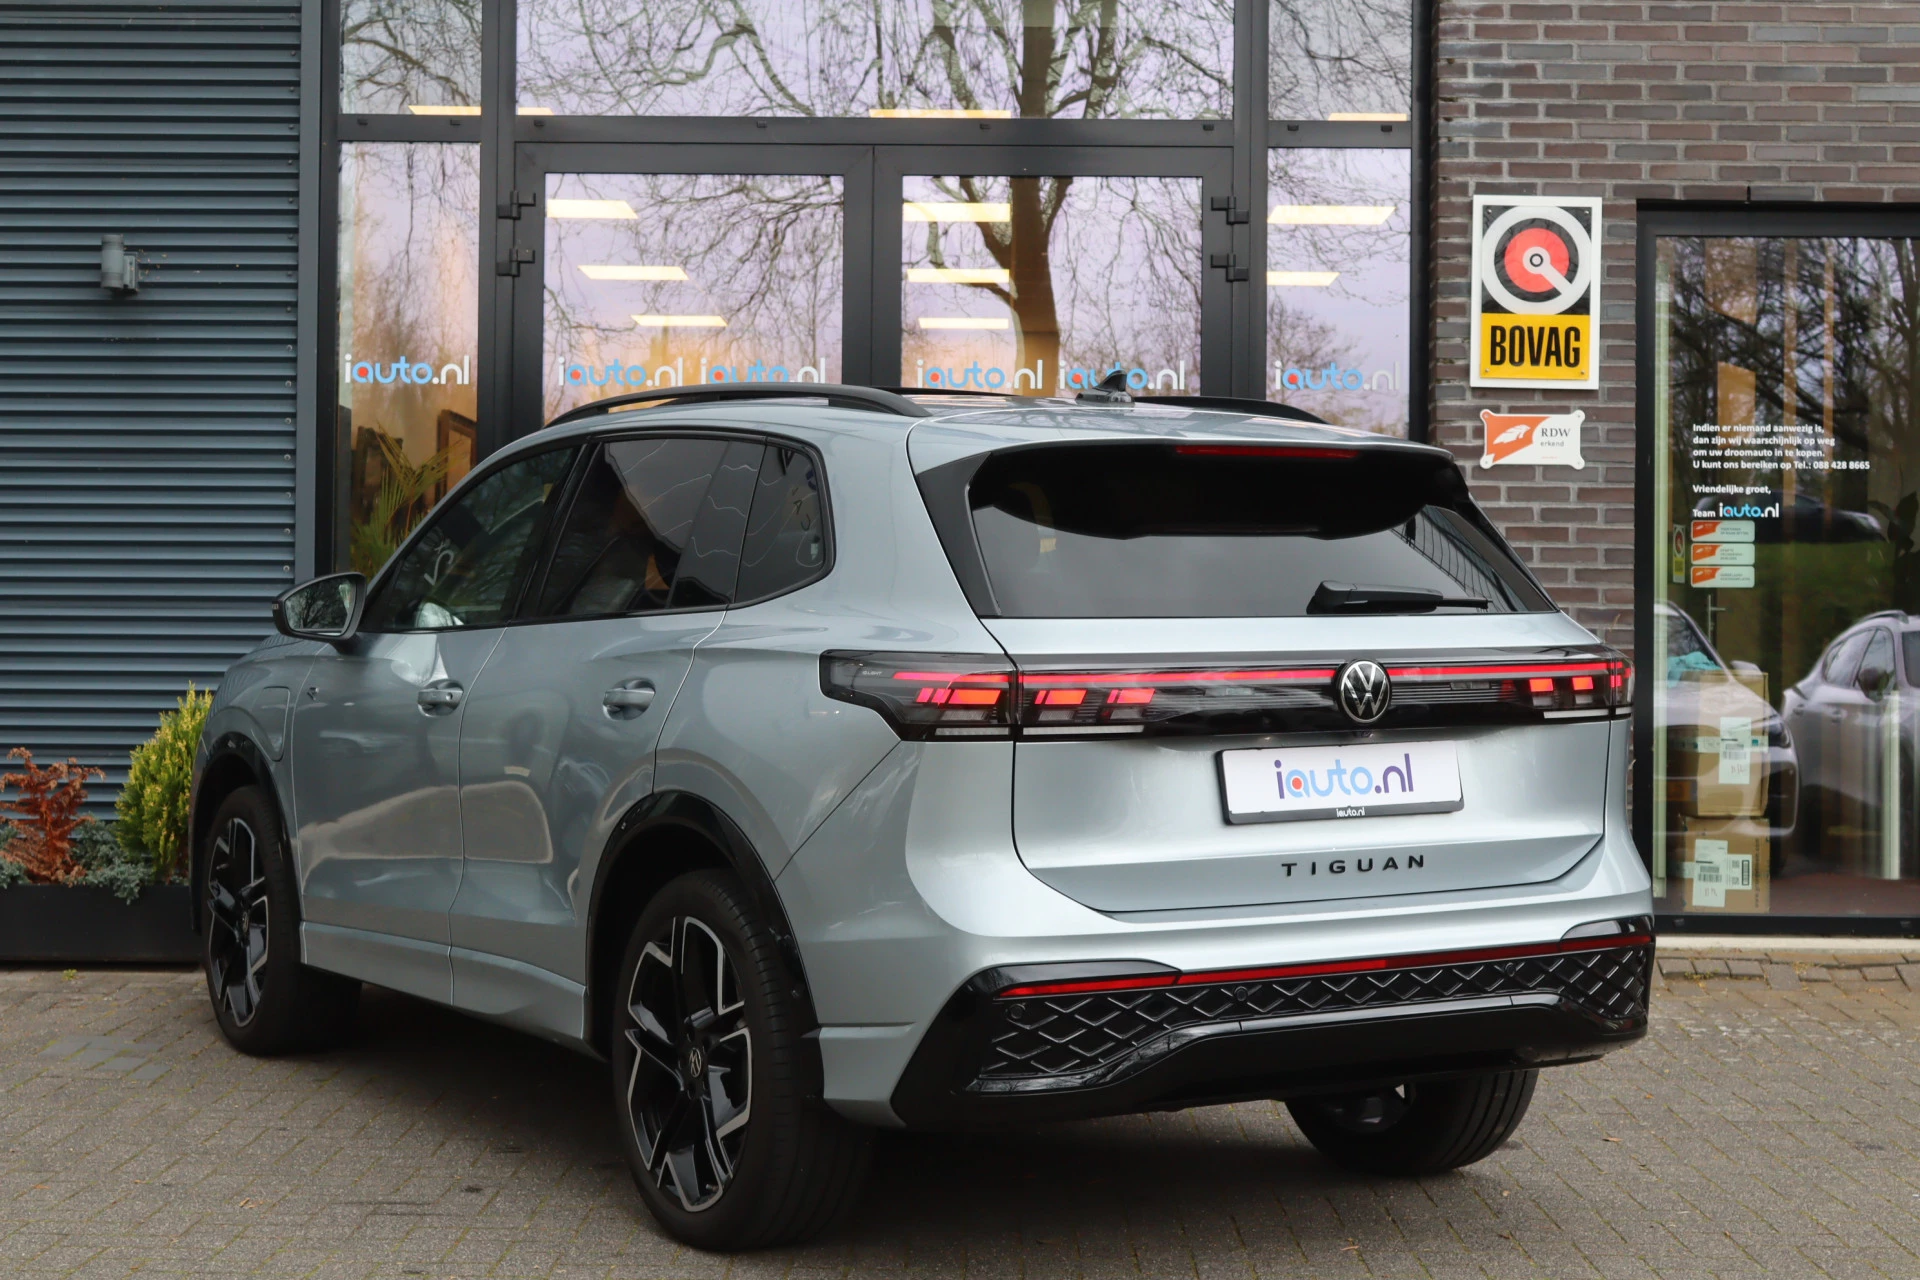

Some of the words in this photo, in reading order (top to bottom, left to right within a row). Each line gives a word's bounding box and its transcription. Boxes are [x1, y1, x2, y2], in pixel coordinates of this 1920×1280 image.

[1490, 325, 1581, 368] BOVAG
[344, 353, 470, 384] iauto.nl
[558, 356, 684, 387] iauto.nl
[917, 359, 1043, 389] iauto.nl
[1274, 360, 1401, 391] iauto.nl
[1541, 428, 1571, 437] RDW
[1693, 424, 1720, 432] Indien
[1733, 424, 1771, 432] niemand
[1773, 424, 1813, 434] aanwezig
[1815, 424, 1824, 434] is,
[1693, 436, 1709, 444] dan
[1711, 436, 1726, 446] zijn
[1728, 436, 1741, 446] wij
[1743, 436, 1802, 446] waarschijnlijk
[1804, 437, 1815, 446] op
[1817, 437, 1835, 446] weg
[1693, 449, 1707, 457] om
[1709, 449, 1722, 457] uw
[1724, 448, 1773, 457] droomauto
[1774, 448, 1783, 457] in
[1785, 449, 1794, 457] te
[1796, 448, 1825, 459] kopen.
[1693, 460, 1700, 469] U
[1702, 460, 1722, 469] kunt
[1723, 461, 1739, 469] ons
[1741, 460, 1778, 469] bereiken
[1780, 462, 1792, 471] op
[1813, 461, 1829, 470] 088
[1831, 461, 1847, 470] 428
[1849, 461, 1870, 470] 8665
[1692, 485, 1744, 495] Vriendelijke
[1745, 485, 1771, 495] groet,
[1692, 509, 1716, 517] Team
[1719, 502, 1779, 518] iauto.nl
[1274, 753, 1414, 799] iauto.nl
[1281, 854, 1425, 877] TIGUAN
